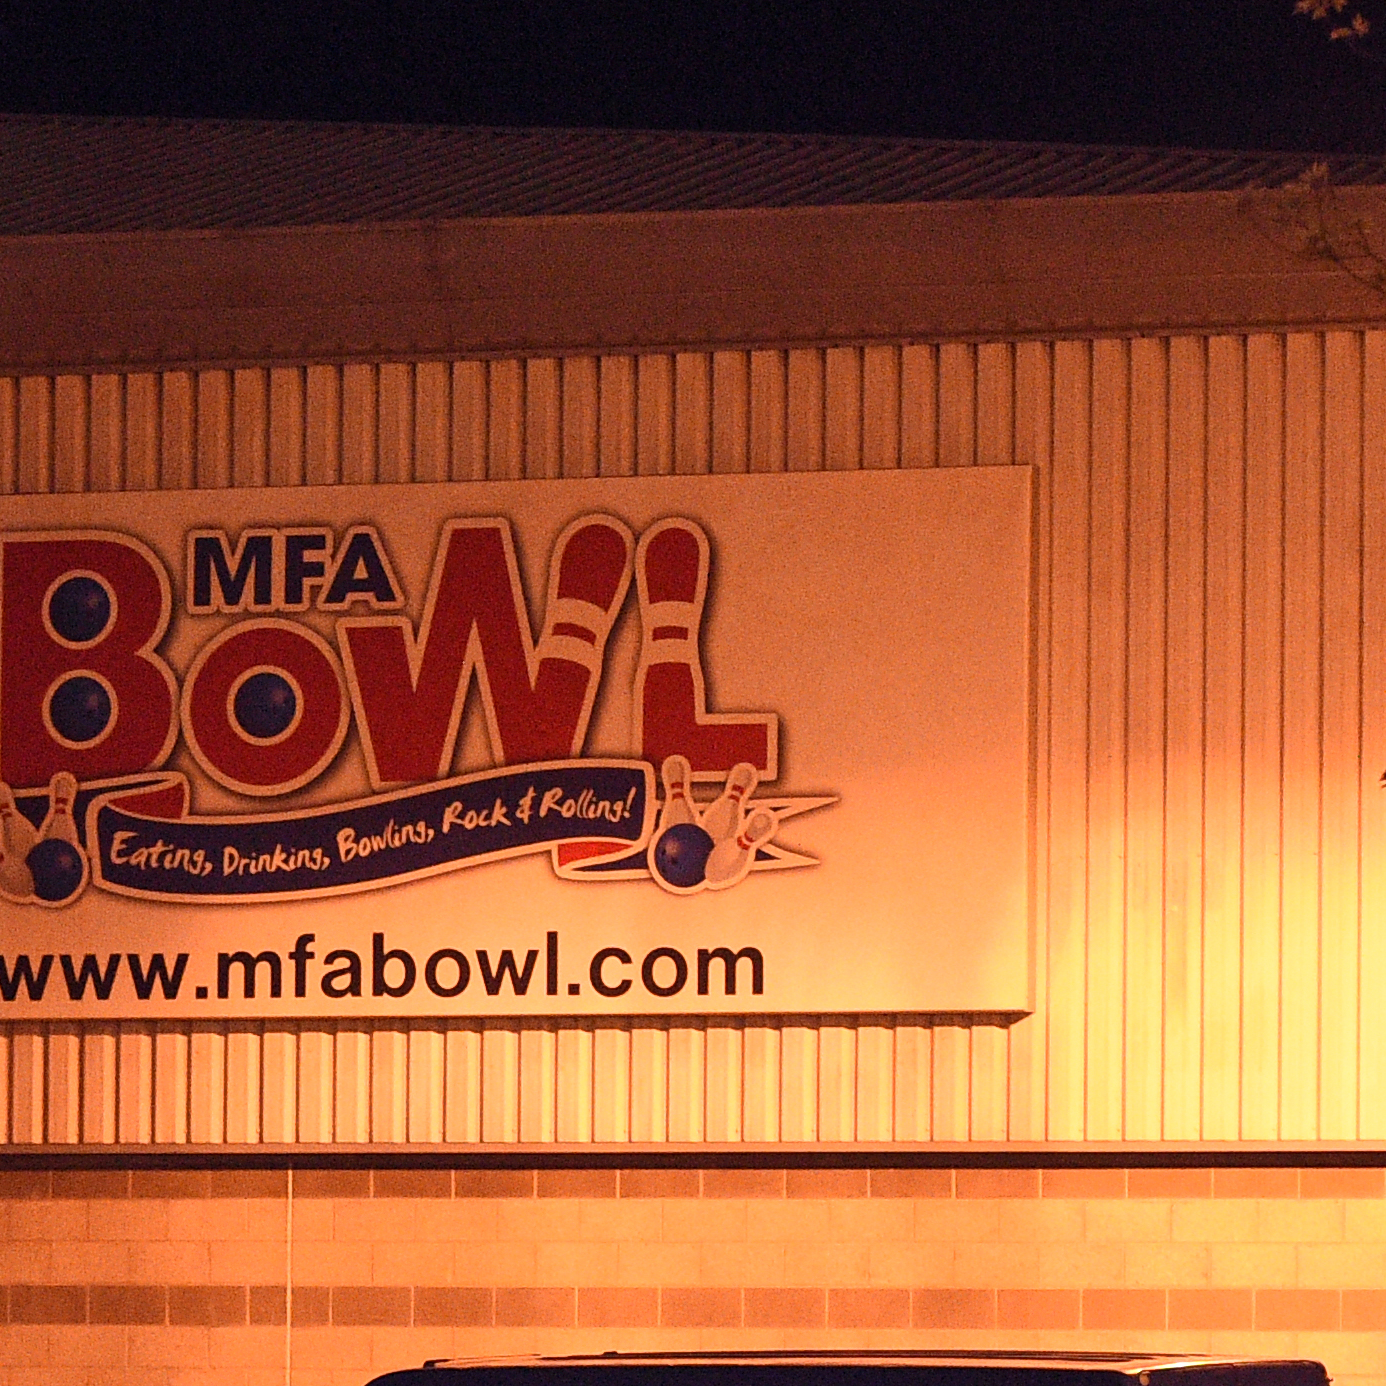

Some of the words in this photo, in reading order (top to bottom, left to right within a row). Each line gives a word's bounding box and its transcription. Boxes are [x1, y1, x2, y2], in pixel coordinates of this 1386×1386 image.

[191, 531, 399, 608] MFA
[110, 831, 213, 876] Eating,
[223, 844, 331, 877] Drinking,
[336, 817, 435, 862] Bowling,
[441, 801, 507, 834] Rock
[538, 786, 639, 824] Rolling!
